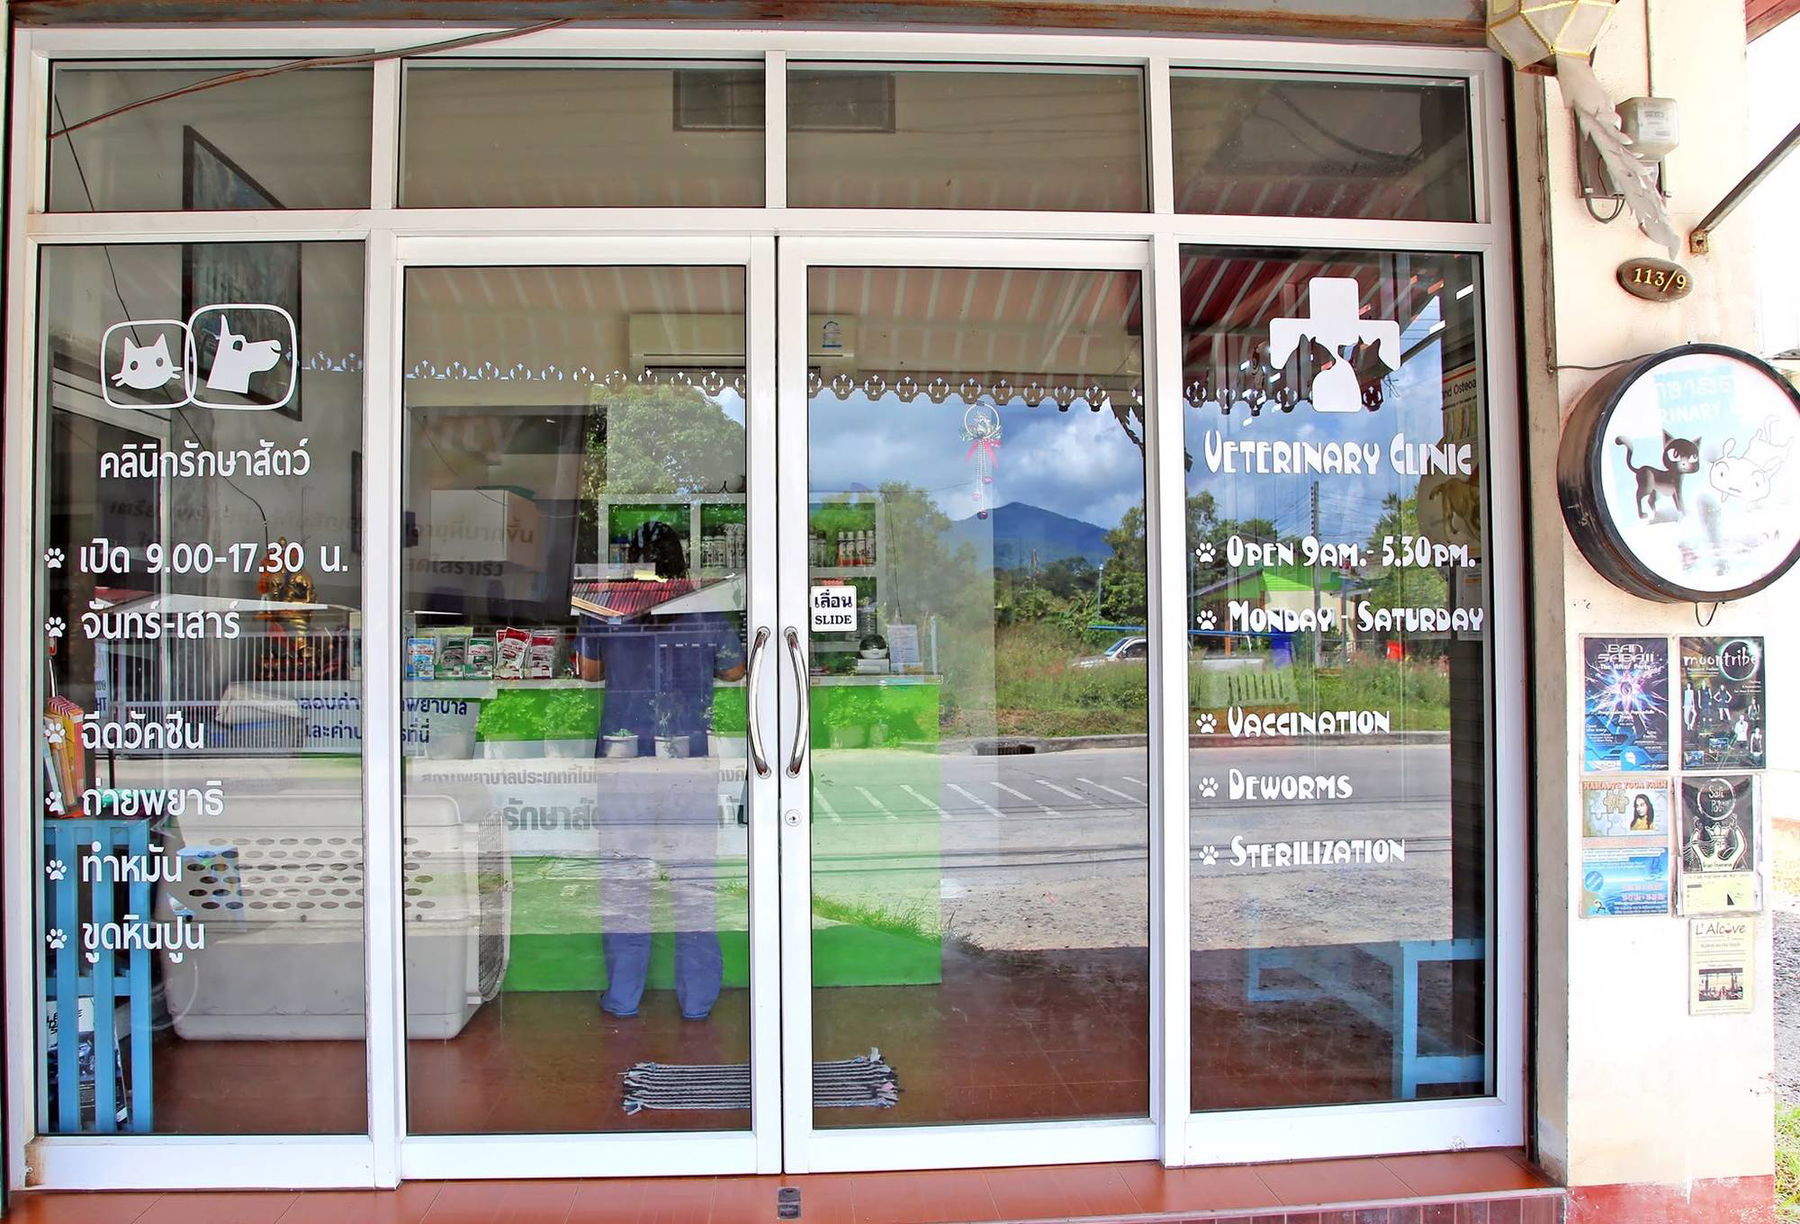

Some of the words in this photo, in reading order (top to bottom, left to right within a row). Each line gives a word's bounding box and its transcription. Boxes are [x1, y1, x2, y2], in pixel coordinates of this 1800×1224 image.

[1634, 267, 1687, 292] 113/9
[100, 438, 310, 478] คลินิกรักษาสัตว์
[1204, 430, 1380, 475] VETERINARY
[1390, 433, 1472, 475] CLINIC
[80, 538, 130, 574] เปิด
[146, 542, 305, 574] 9.00-17.30
[321, 544, 348, 573] น.
[1227, 535, 1295, 567] OPEN
[1382, 535, 1476, 567] 5.30PM.
[814, 589, 853, 608] เลื่อน
[80, 601, 240, 639] จันทร์-เสาร์
[815, 615, 852, 625] SLIDE
[1228, 601, 1333, 632] MONDAY
[1357, 601, 1484, 632] SATURDAY
[1683, 647, 1760, 667] moontribe
[80, 711, 205, 749] ฉีดวัคซีน
[1227, 706, 1391, 738] VACCINATION
[81, 776, 224, 816] ถ่ายพยาธิ
[1229, 768, 1353, 800] DEWORMS
[82, 841, 182, 882] ทำหมัน
[1230, 835, 1406, 868] STERILIZATION
[82, 914, 205, 963] ขูดหินปูน
